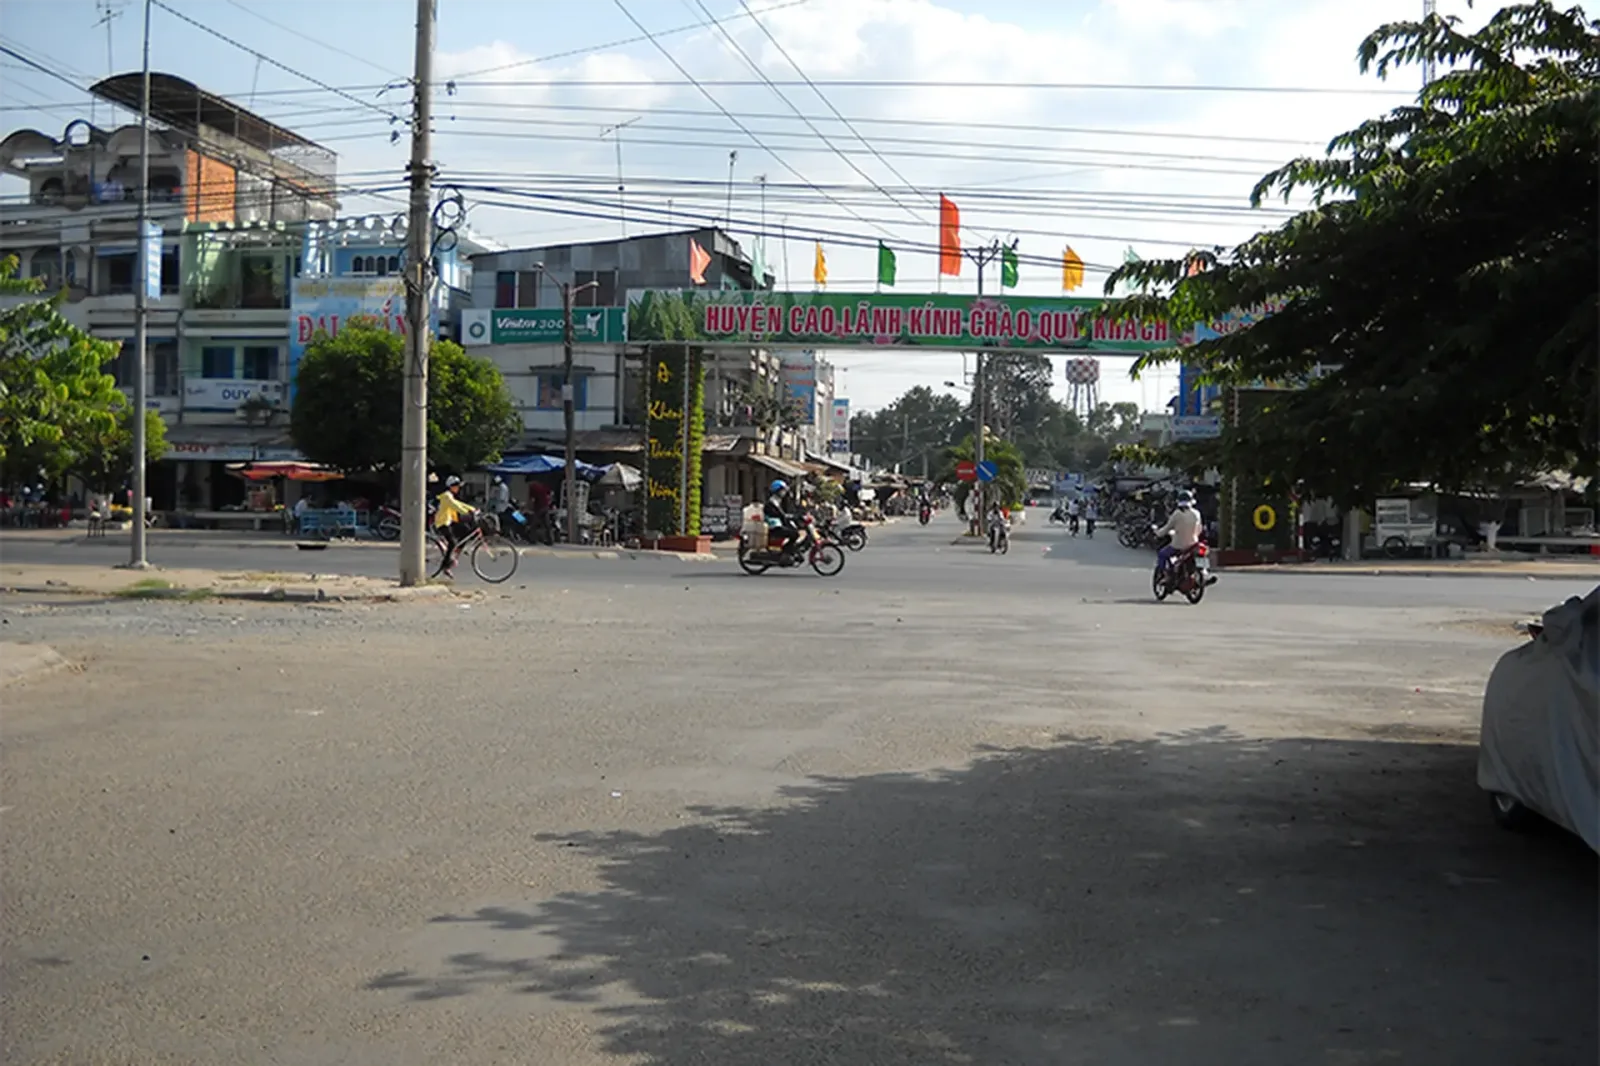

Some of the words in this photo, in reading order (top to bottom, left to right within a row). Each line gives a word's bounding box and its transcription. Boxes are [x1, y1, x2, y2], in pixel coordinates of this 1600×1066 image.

[705, 302, 782, 340] HUYỆN
[789, 306, 835, 333] CAO
[843, 302, 901, 335] LÃNH
[909, 303, 962, 337] KÍNH
[970, 305, 1032, 339] CHÀO
